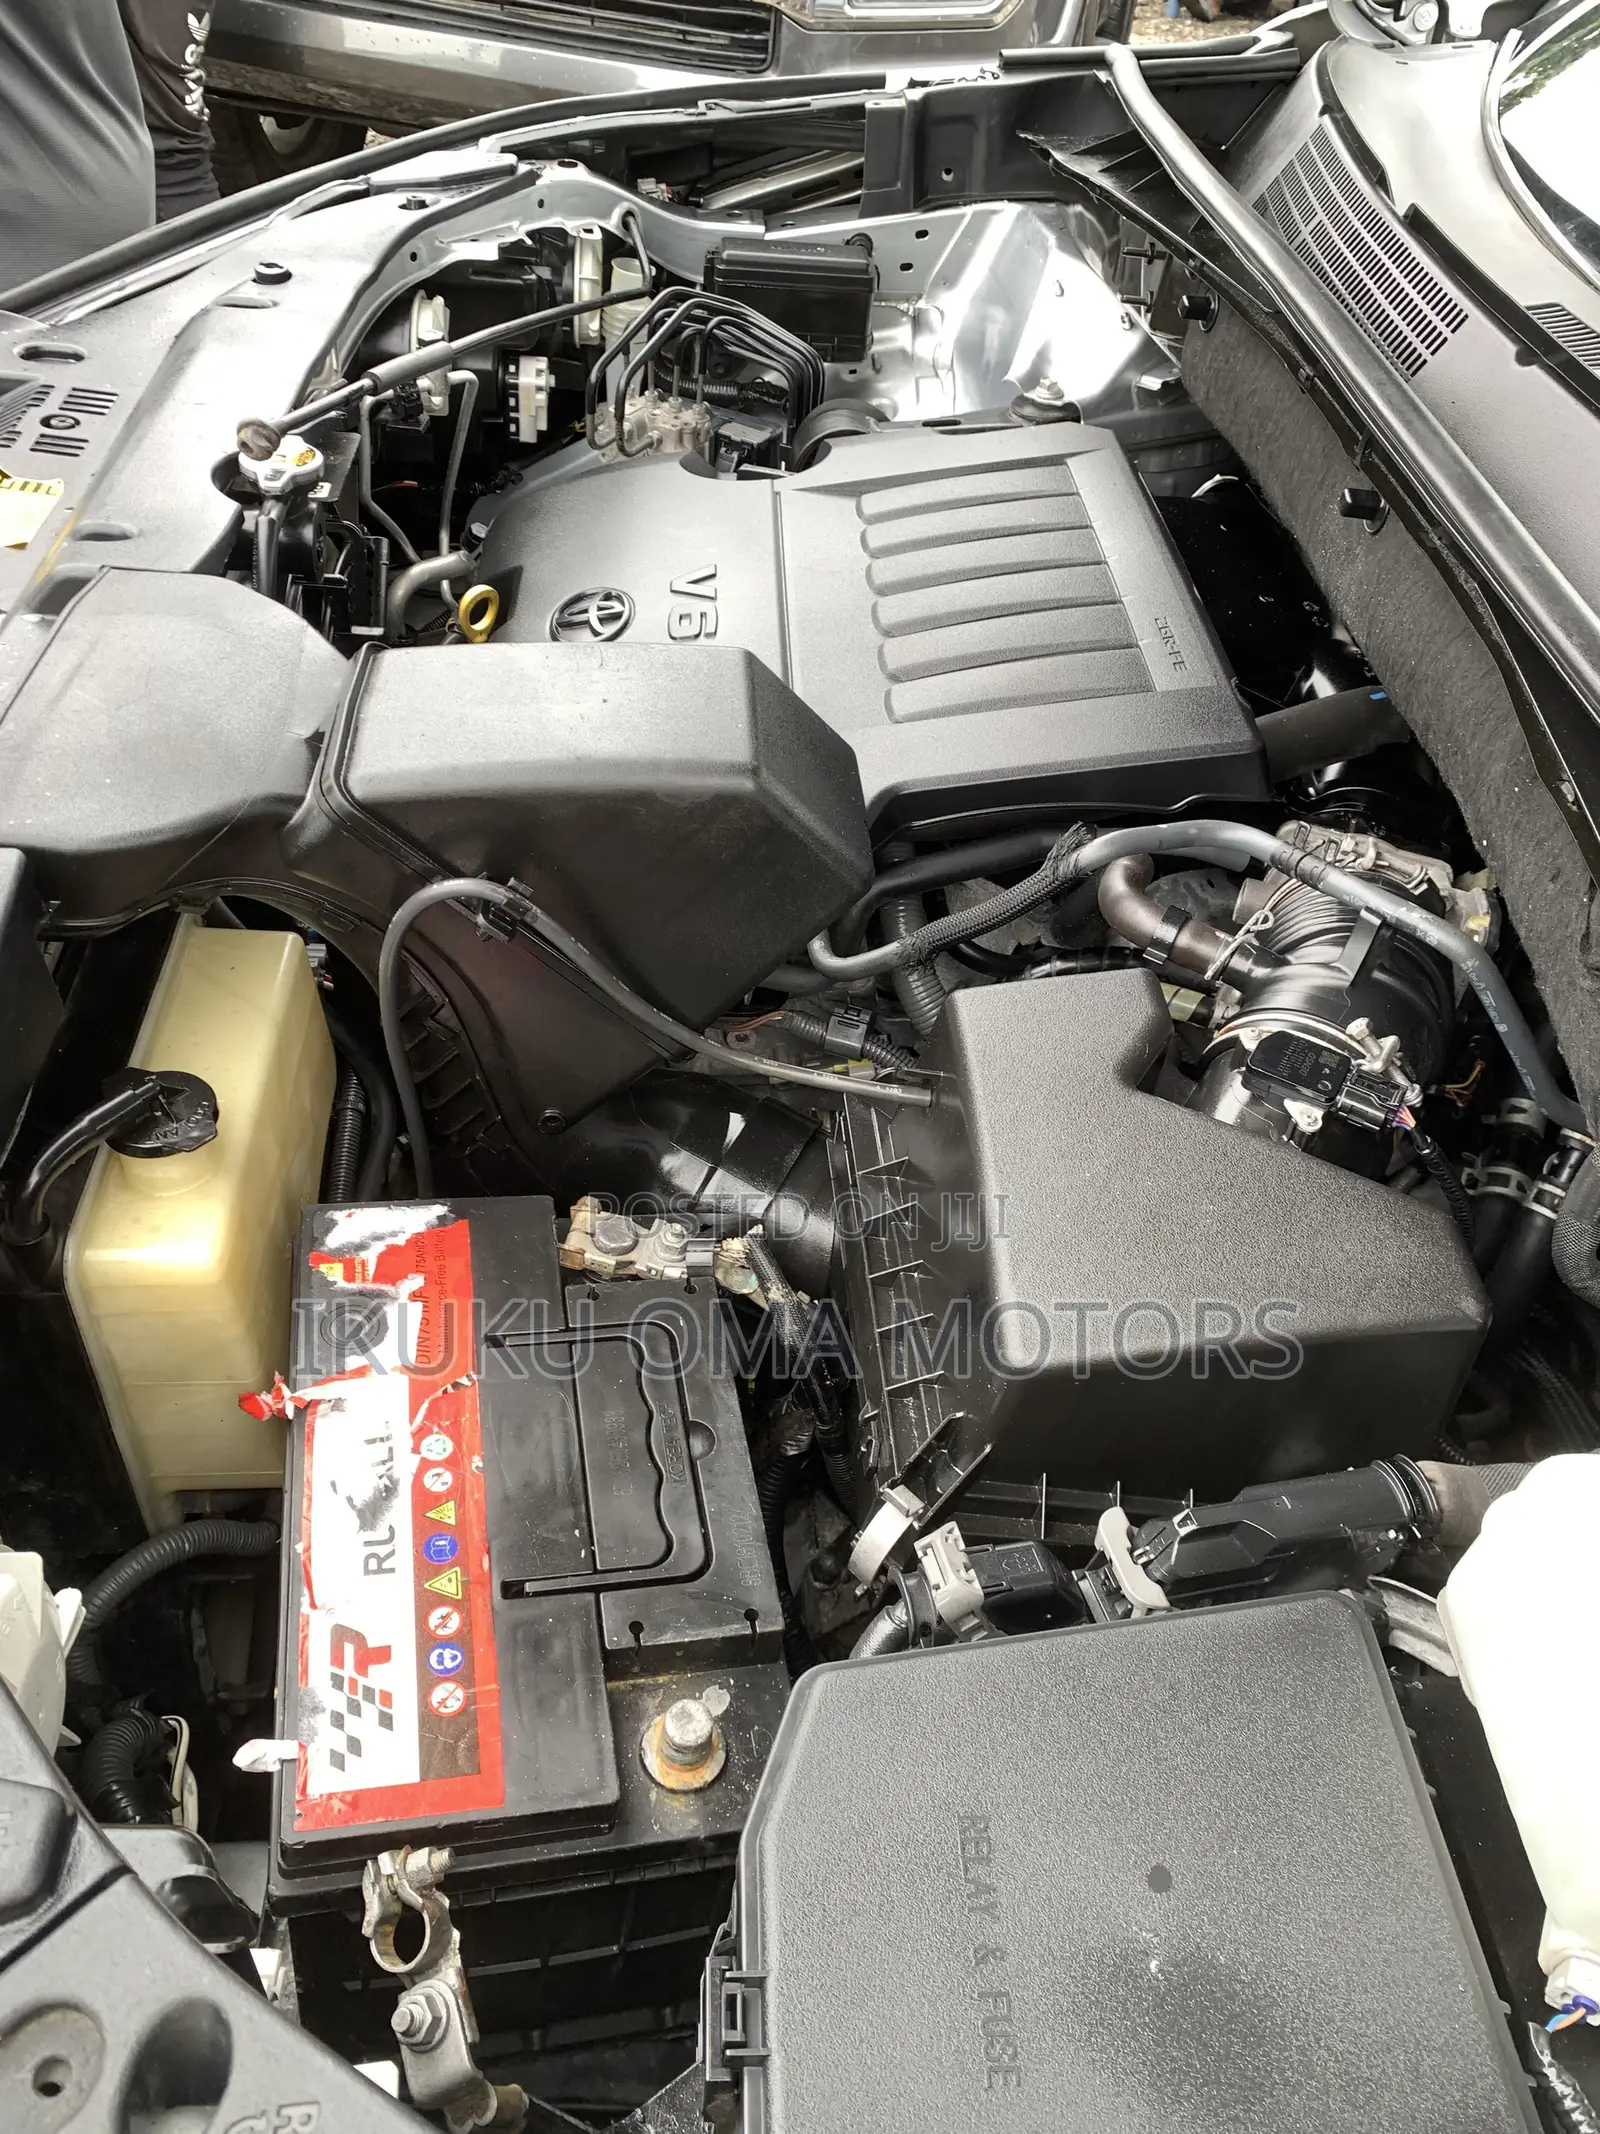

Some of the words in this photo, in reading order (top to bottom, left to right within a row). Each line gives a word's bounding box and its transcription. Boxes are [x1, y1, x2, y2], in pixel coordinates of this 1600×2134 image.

[668, 563, 719, 641] V6
[1154, 616, 1188, 673] 2GR-FE
[434, 1229, 447, 1262] Battery
[657, 1402, 680, 1434] TECH
[664, 1435, 687, 1481] KOREA
[957, 1815, 1001, 1921] RELAY
[973, 1942, 1004, 1967] &
[976, 1990, 1022, 2090] FUSE
